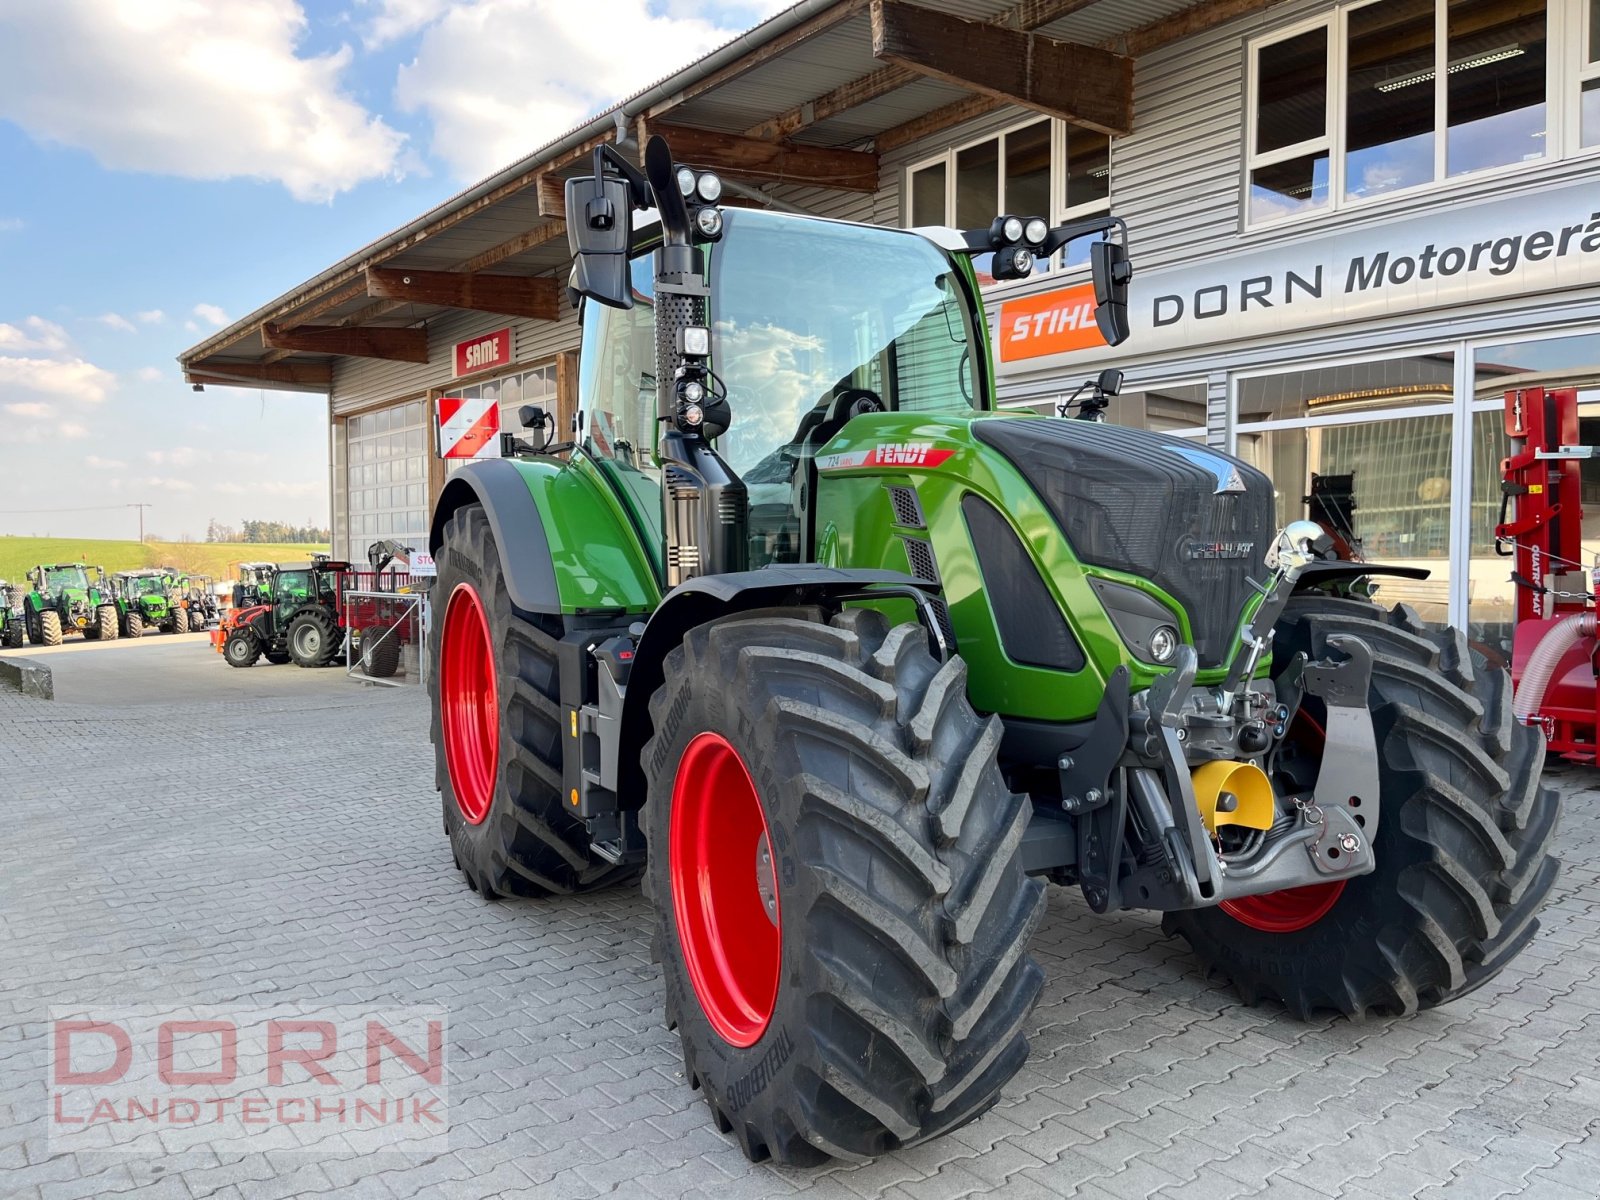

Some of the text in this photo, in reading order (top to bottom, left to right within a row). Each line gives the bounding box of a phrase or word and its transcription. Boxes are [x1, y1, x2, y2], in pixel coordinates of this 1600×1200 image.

[1153, 265, 1323, 328] DORN
[1010, 303, 1097, 342] STIHL
[466, 337, 499, 369] SAME
[828, 455, 840, 467] 724
[875, 442, 933, 464] FENDT
[1190, 542, 1254, 559] FENDT
[650, 677, 692, 782] TRELLEBORG
[726, 1023, 795, 1113] TRELLEBORG
